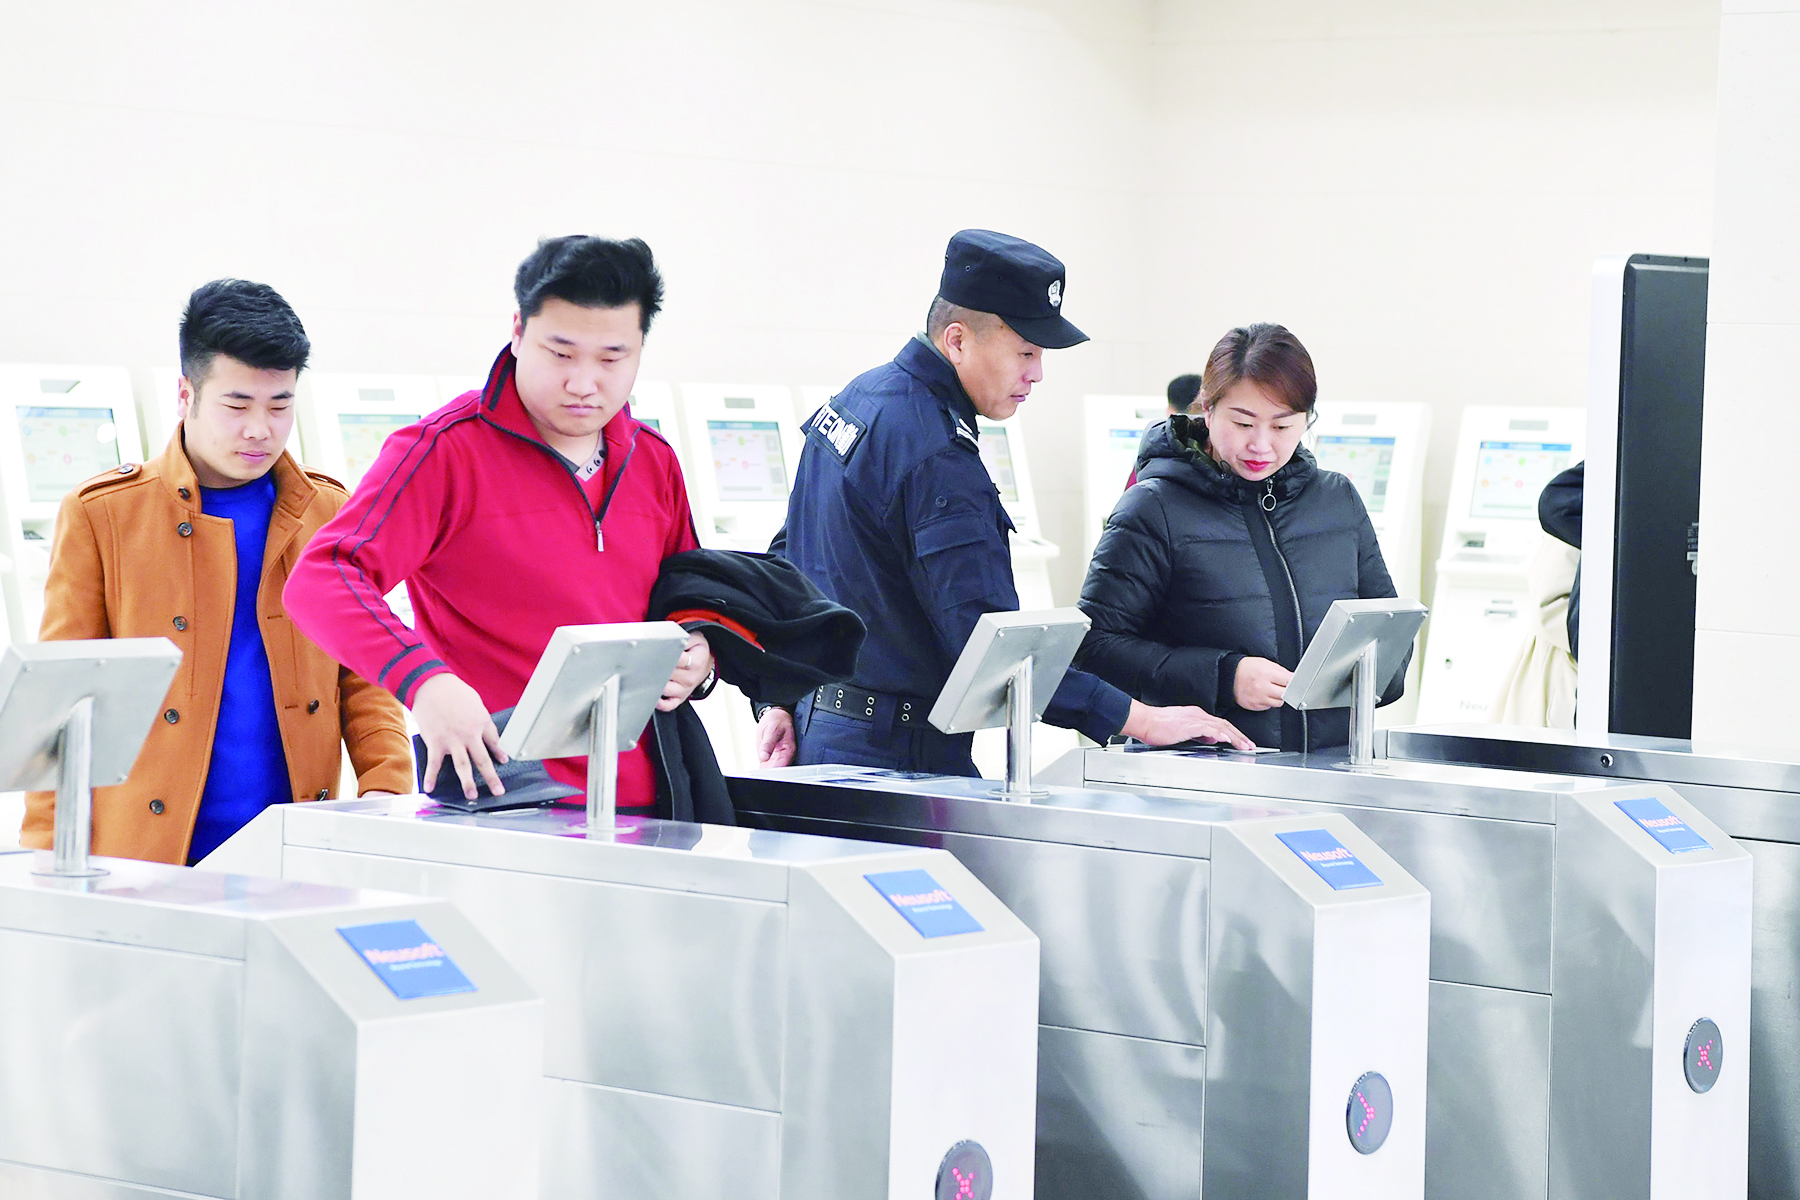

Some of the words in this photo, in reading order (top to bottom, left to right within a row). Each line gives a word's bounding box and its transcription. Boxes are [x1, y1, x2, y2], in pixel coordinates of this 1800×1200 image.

[1459, 700, 1489, 712] Neu
[1638, 815, 1684, 829] Neusoft
[1300, 847, 1354, 862] Neusoft
[888, 889, 954, 907] Neusoft
[363, 942, 446, 965] Neusoft
